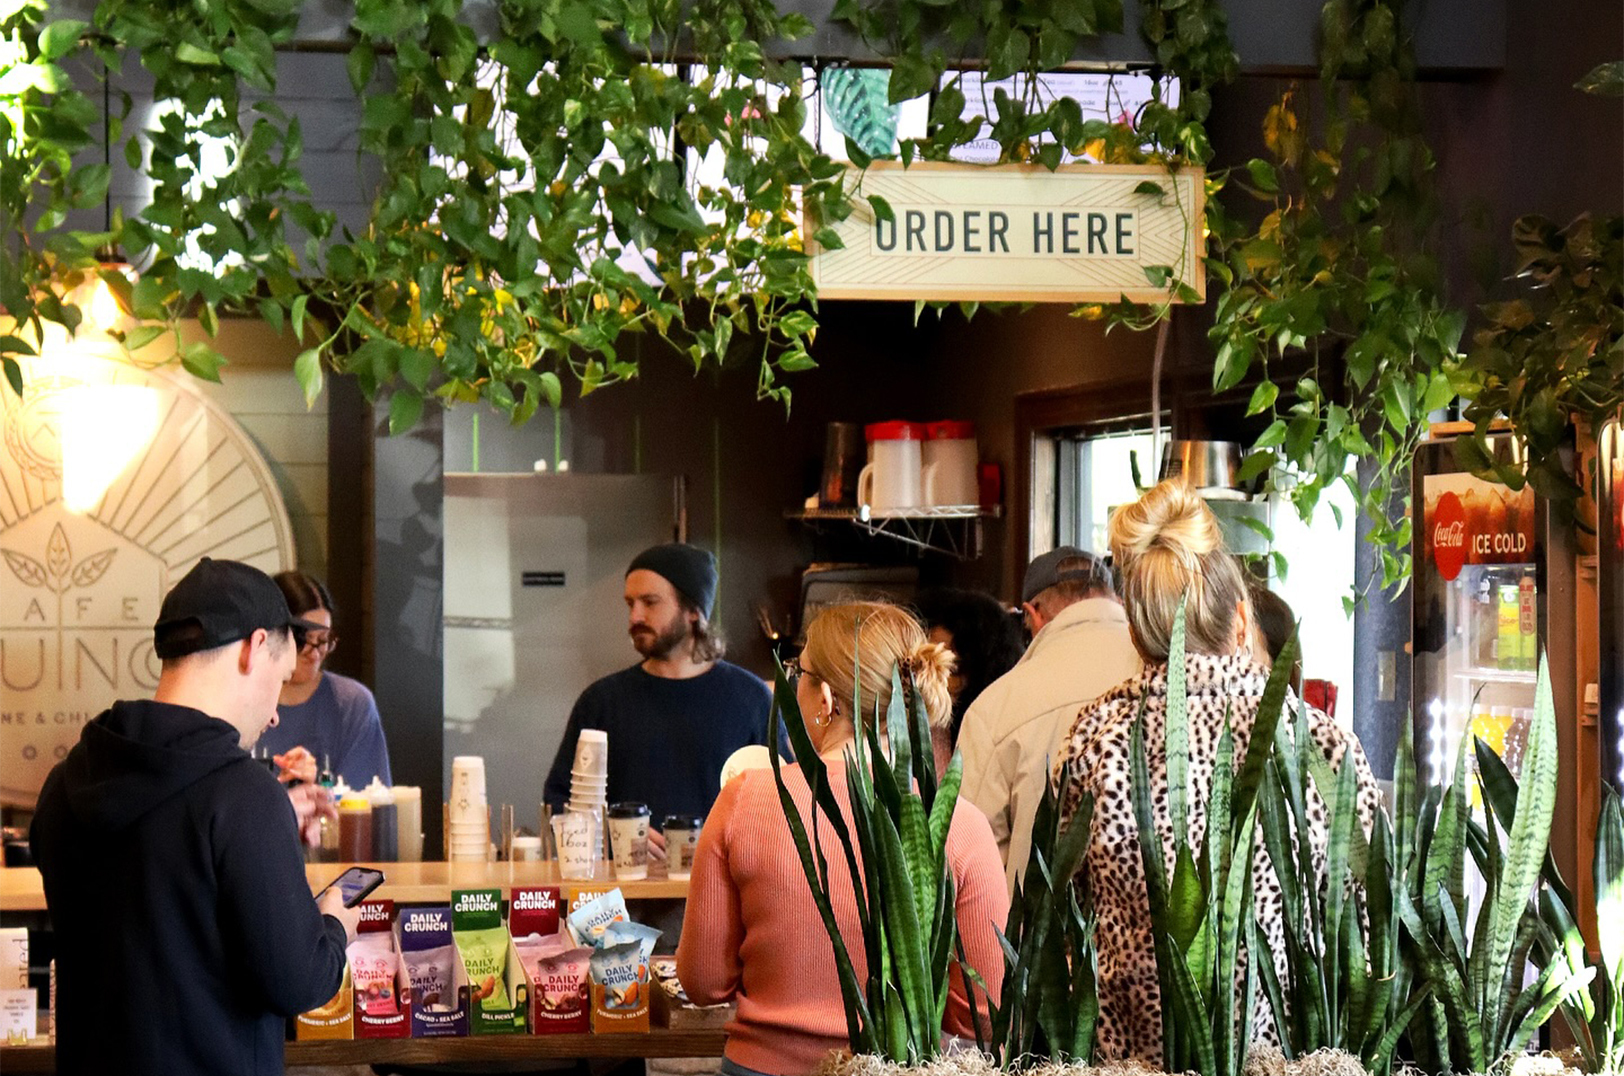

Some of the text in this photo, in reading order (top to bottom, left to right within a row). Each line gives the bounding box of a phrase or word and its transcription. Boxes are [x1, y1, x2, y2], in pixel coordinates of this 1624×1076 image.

[876, 209, 1134, 255] ORDER HERE
[1472, 532, 1527, 554] ICE COLD
[35, 711, 45, 725] &
[53, 711, 90, 725] CHI
[560, 833, 588, 849] 16oz
[461, 894, 492, 904] DAILY
[519, 891, 551, 901] DAILY
[579, 892, 606, 901] DAI
[360, 904, 385, 914] AILY
[455, 902, 498, 912] CRUNCH
[513, 900, 556, 910] CRUNCH
[360, 912, 390, 921] UNCH
[410, 913, 443, 923] DAILY
[404, 922, 448, 932] CRUNCH
[464, 958, 494, 968] DAILY
[465, 965, 500, 976] RUNCH
[605, 964, 633, 977] DAILY
[410, 976, 438, 986] DAILY
[548, 975, 580, 984] DAILY
[601, 972, 639, 986] CRUNCH
[543, 983, 579, 993] CRUNC
[414, 1012, 435, 1023] CACAO
[440, 1015, 451, 1023] SEA
[450, 1011, 465, 1020] SALT
[540, 1011, 563, 1020] CHERRY
